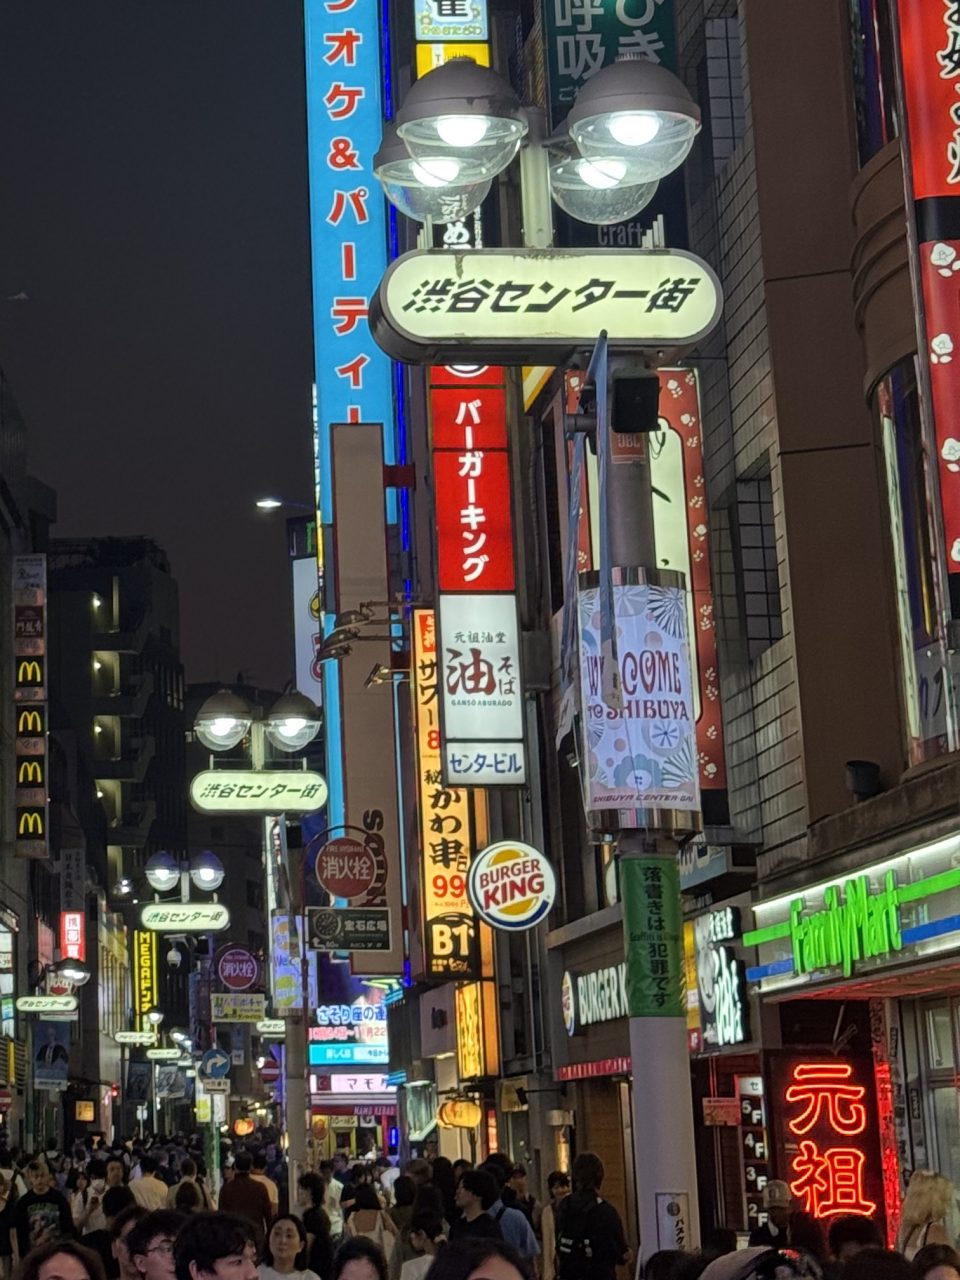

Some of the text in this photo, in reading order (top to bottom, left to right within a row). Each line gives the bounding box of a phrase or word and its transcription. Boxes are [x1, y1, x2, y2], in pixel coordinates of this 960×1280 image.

[402, 277, 701, 314] 渋谷センター街
[455, 399, 490, 582] バーガーキング
[587, 650, 681, 696] WCOME
[606, 700, 689, 720] SHIBUYA
[427, 729, 440, 750] 8
[450, 752, 522, 774] センタービル
[200, 783, 322, 799] 渋谷センター街
[322, 855, 371, 879] 消火栓
[479, 857, 541, 890] BURGER
[483, 873, 545, 912] KING
[146, 911, 224, 923] 渋谷センター街
[790, 869, 902, 978] FamilyMart
[432, 924, 469, 956] B1
[223, 961, 253, 977] 消火栓
[577, 968, 620, 1026] BURGER
[742, 1099, 762, 1124] 5F
[744, 1132, 765, 1158] 4F
[786, 1064, 877, 1218] 元祖
[746, 1166, 767, 1191] 3F
[748, 1202, 769, 1228] 2F
